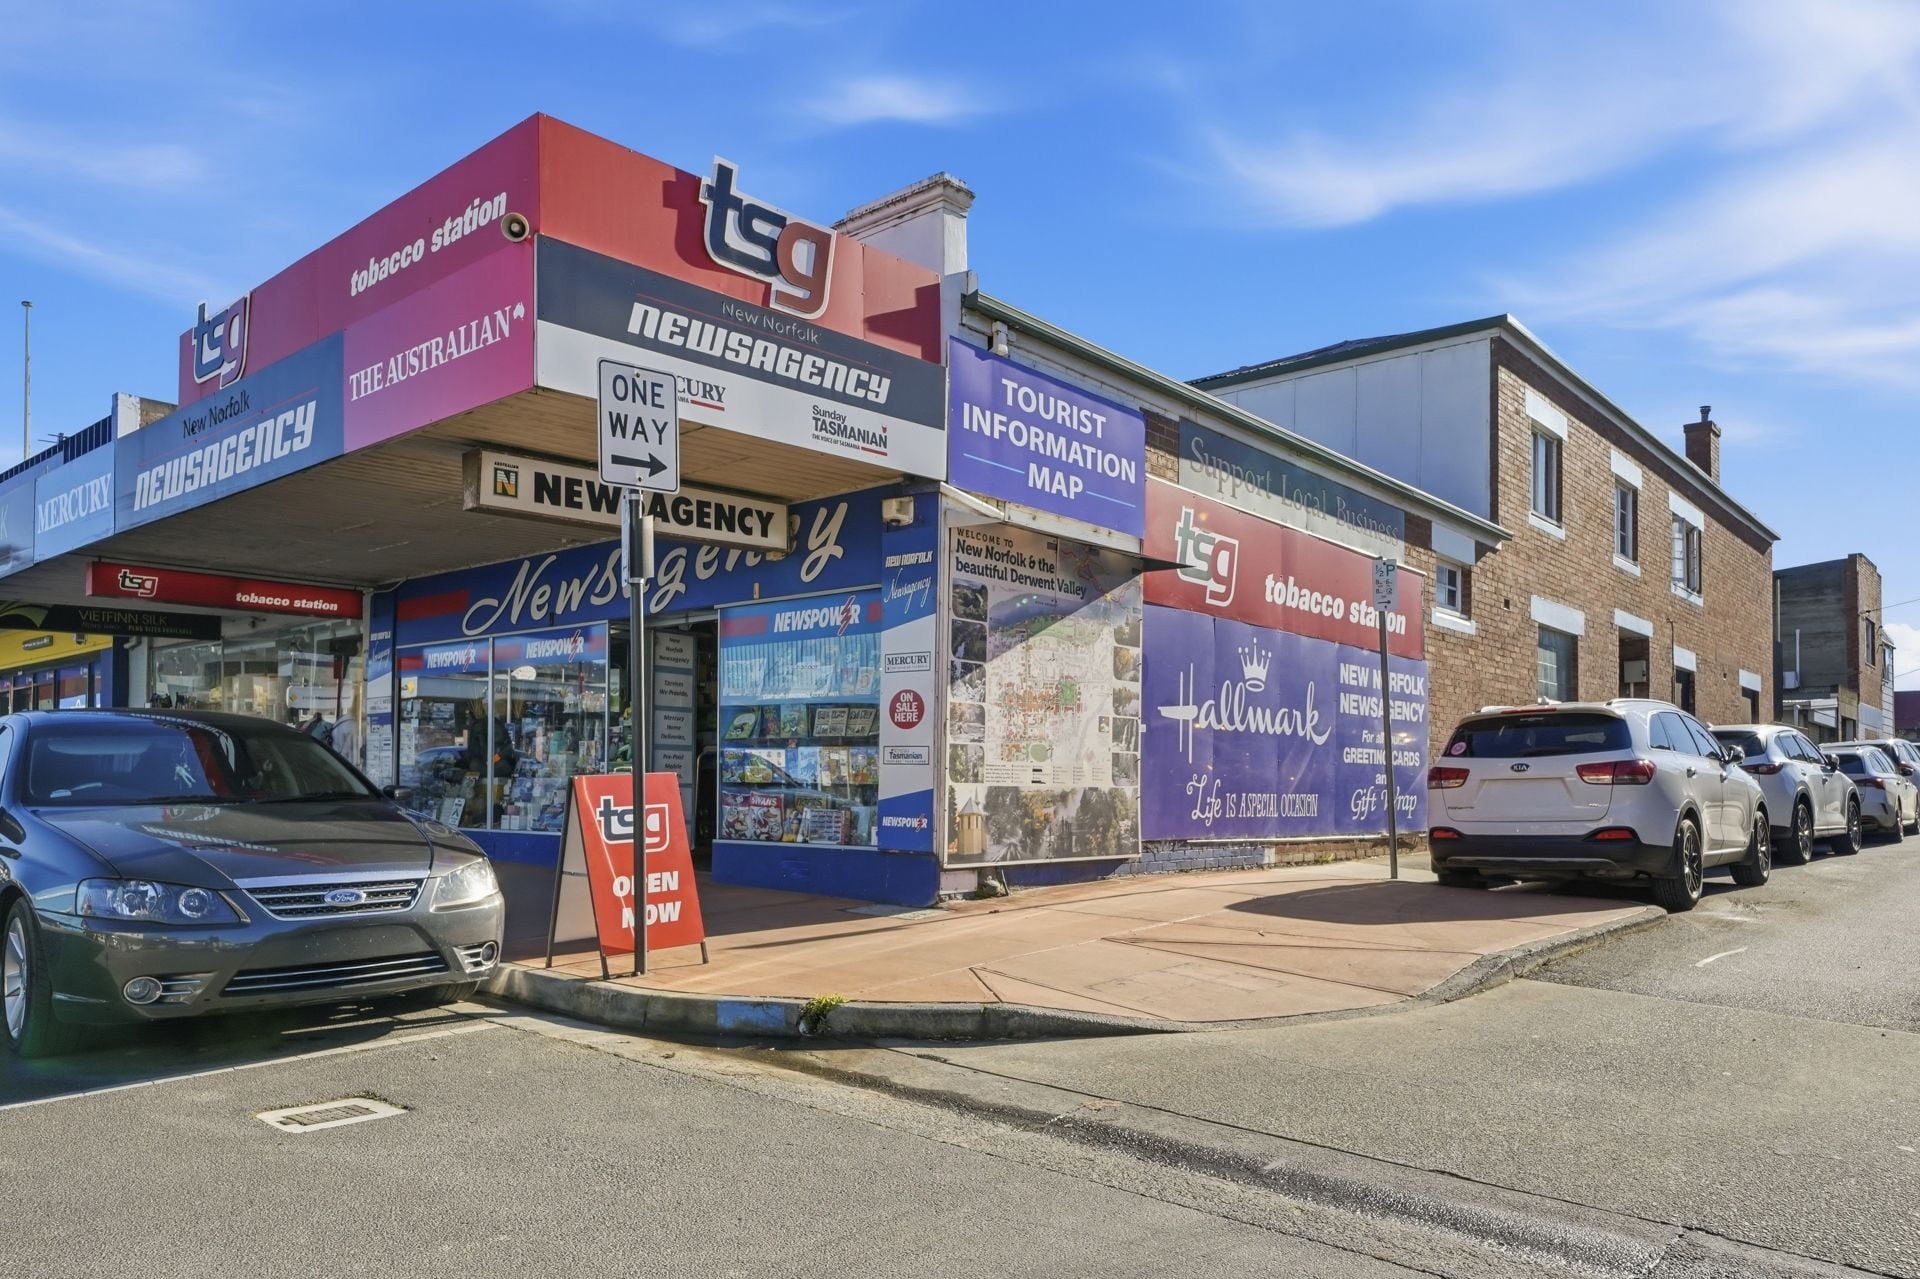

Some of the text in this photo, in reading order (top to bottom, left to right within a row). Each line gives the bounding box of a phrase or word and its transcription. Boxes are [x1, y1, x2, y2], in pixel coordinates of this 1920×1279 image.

[350, 192, 507, 297] tobacco station
[700, 157, 836, 319] tsg
[722, 301, 819, 345] New Norfolk
[192, 293, 251, 389] tsg
[350, 306, 512, 402] THE AUSTRALIAN
[627, 302, 891, 405] NEWSAGENCY
[612, 374, 665, 409] ONE
[1002, 378, 1106, 439] TOURIST
[183, 389, 251, 438] New Norfolk
[608, 411, 668, 445] WAY
[812, 405, 847, 424] Sunday
[812, 416, 888, 449] TASMANIAN
[963, 402, 1136, 484] INFORMATION
[134, 401, 316, 511] NEWSAGENCY
[494, 461, 519, 469] AUSTRALIAN
[1028, 462, 1083, 500] MAP
[1190, 436, 1399, 547] Support Local Business
[36, 473, 112, 534] MERCURY
[535, 472, 775, 538] NEWAGENCY
[957, 527, 1013, 548] WELCOME TO
[901, 550, 933, 566] NORFOLK
[956, 538, 1055, 574] New Norfolk & the
[1175, 505, 1239, 608] tsg
[1386, 564, 1396, 576] P
[118, 568, 158, 597] tsg
[883, 567, 931, 614] Newsagency
[956, 556, 1087, 600] beautiful Derwent Valley
[79, 609, 167, 625] VIETFINN SILK
[236, 591, 338, 612] tobacco station
[1265, 574, 1344, 620] tobacco
[1349, 600, 1406, 635] staon
[887, 655, 929, 666] MERCURY
[900, 692, 914, 702] ON
[1340, 663, 1424, 697] NEW NRFOLK
[894, 712, 919, 722] HERE
[896, 702, 918, 712] SALE
[1158, 663, 1332, 765] Hallmark
[1362, 729, 1374, 744] For
[889, 751, 922, 760] Tasmanian
[1391, 750, 1420, 767] CARDS
[1375, 773, 1387, 785] an
[1186, 773, 1318, 827] Life IS A SPECIAL OCCASION
[1351, 786, 1377, 821] Gift
[335, 892, 356, 902] Ford
